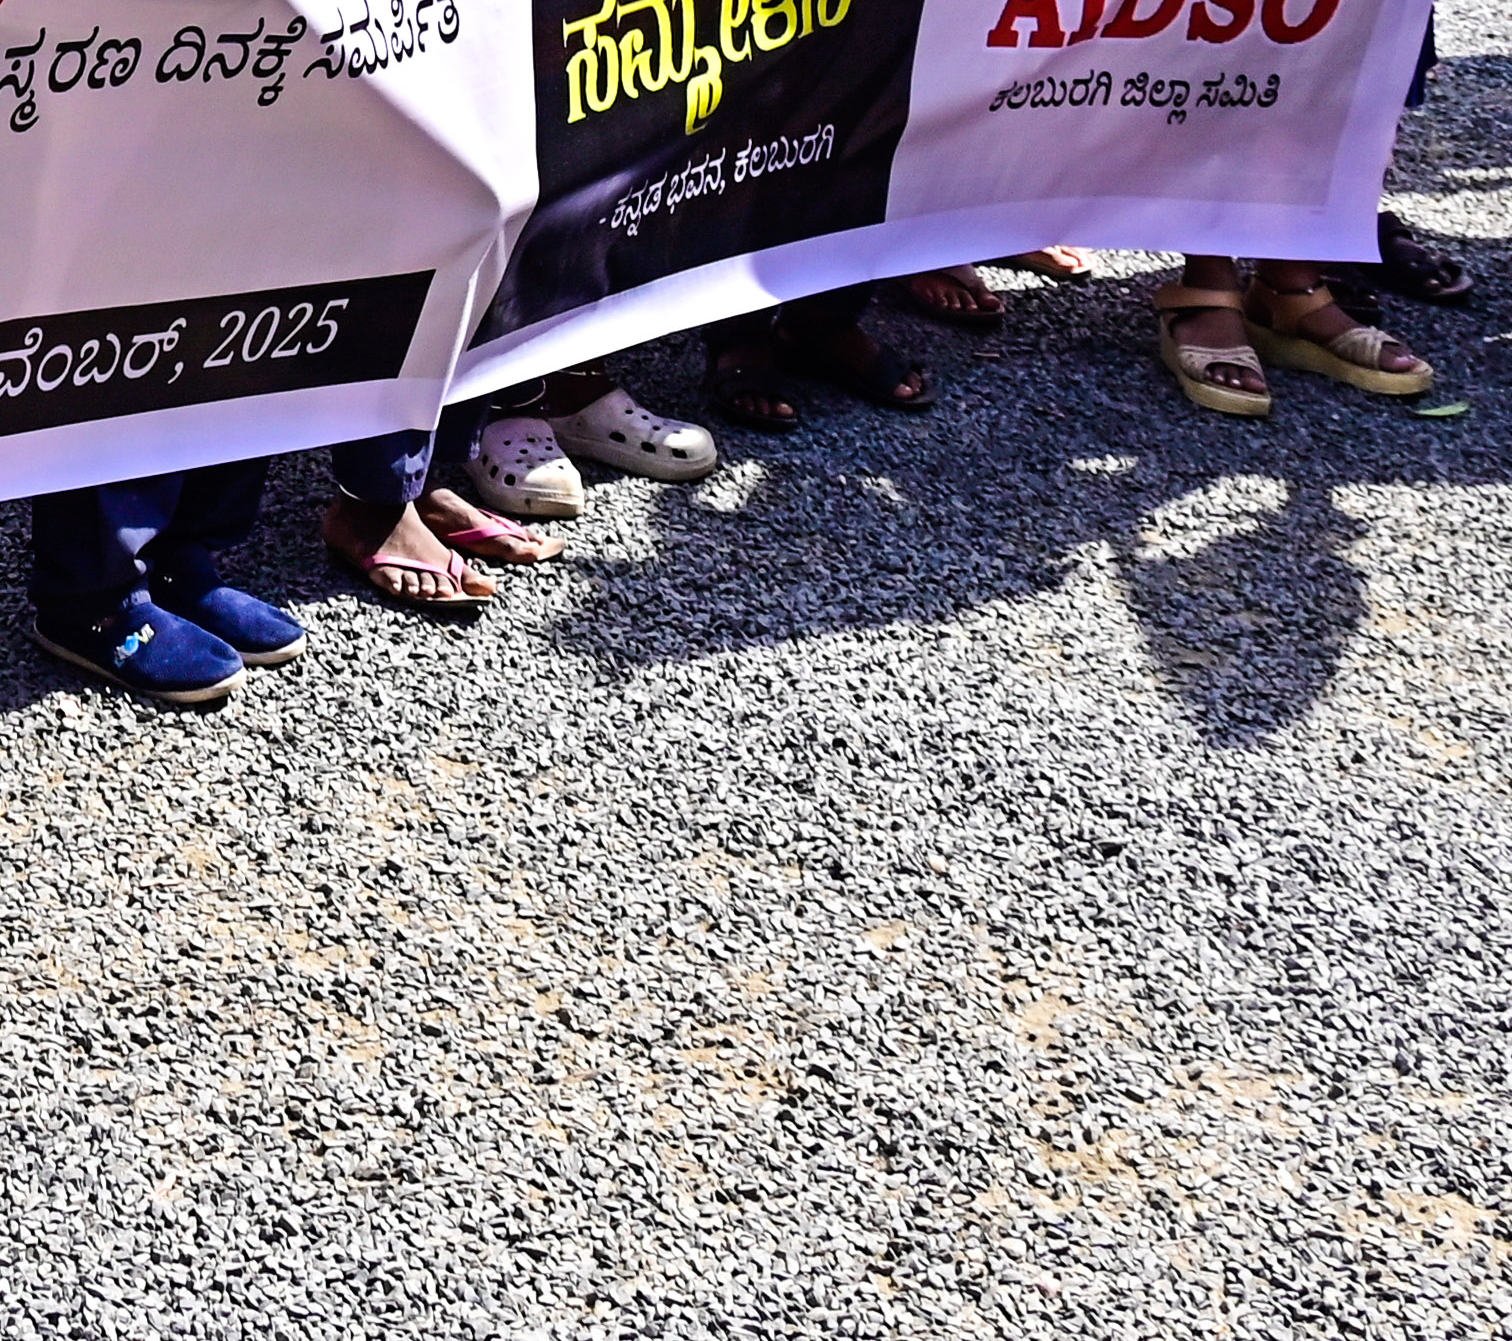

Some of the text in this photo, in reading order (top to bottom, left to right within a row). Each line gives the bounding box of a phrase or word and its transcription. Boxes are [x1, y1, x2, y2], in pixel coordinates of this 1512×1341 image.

[156, 14, 305, 107] ದಿನಕ್ಕೆ
[988, 70, 1280, 125] ಕಲಬುರಗಿ ಜಿಲ್ಲಾ ಸಮಿತಿ
[733, 124, 836, 184] ಕಲಬುರಗಿ
[203, 298, 350, 366] 2025
